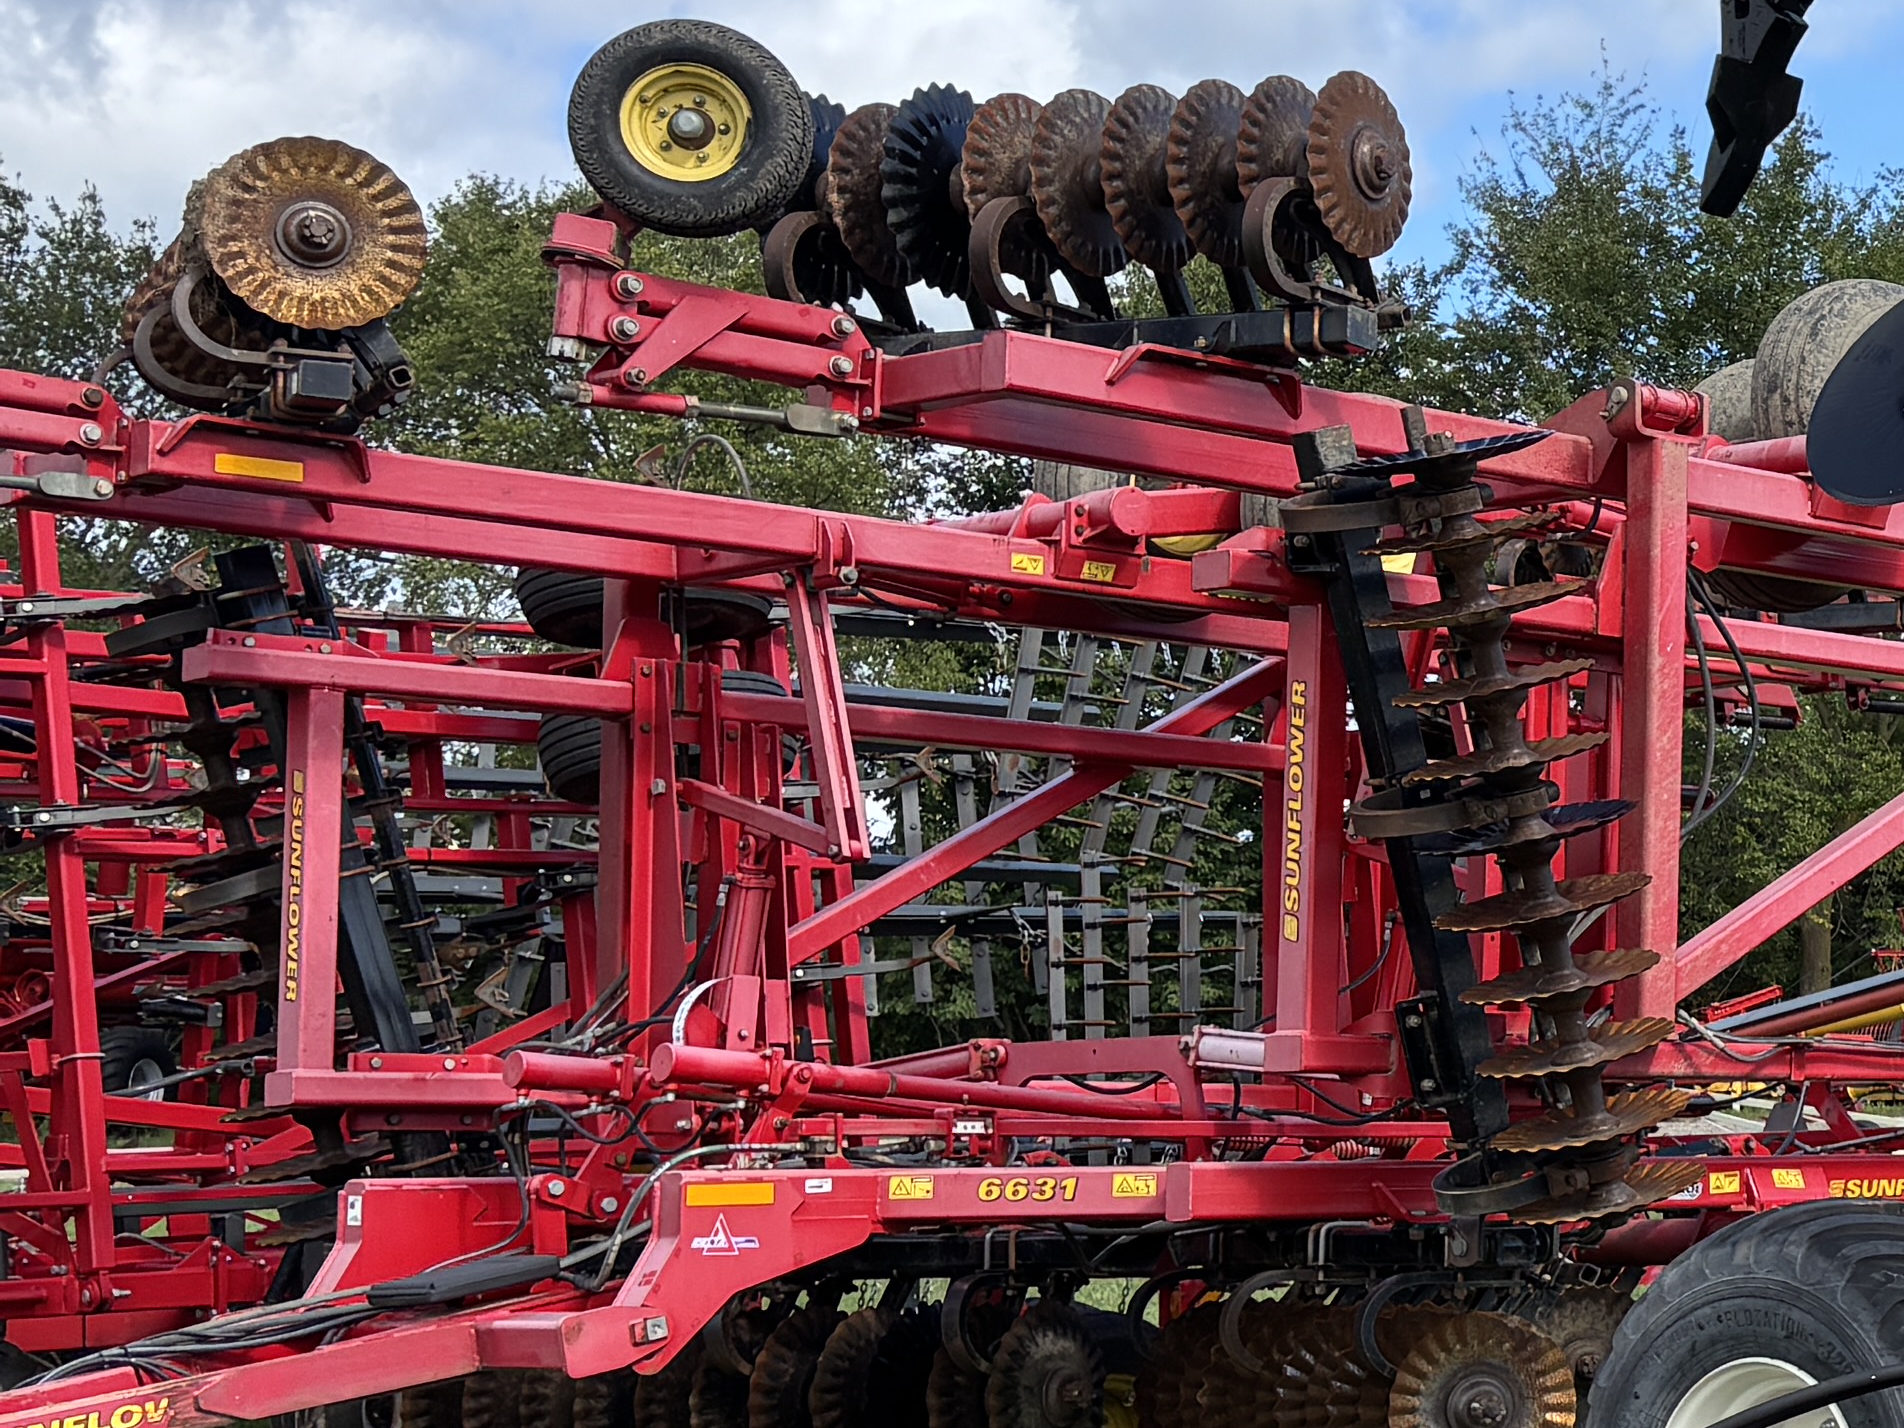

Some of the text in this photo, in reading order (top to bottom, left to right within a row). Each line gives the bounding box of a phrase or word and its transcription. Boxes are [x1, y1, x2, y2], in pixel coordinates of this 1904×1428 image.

[285, 796, 304, 1002] SUNFLOWER
[1284, 679, 1307, 913] SUNFLOWER
[977, 1176, 1079, 1202] 6631
